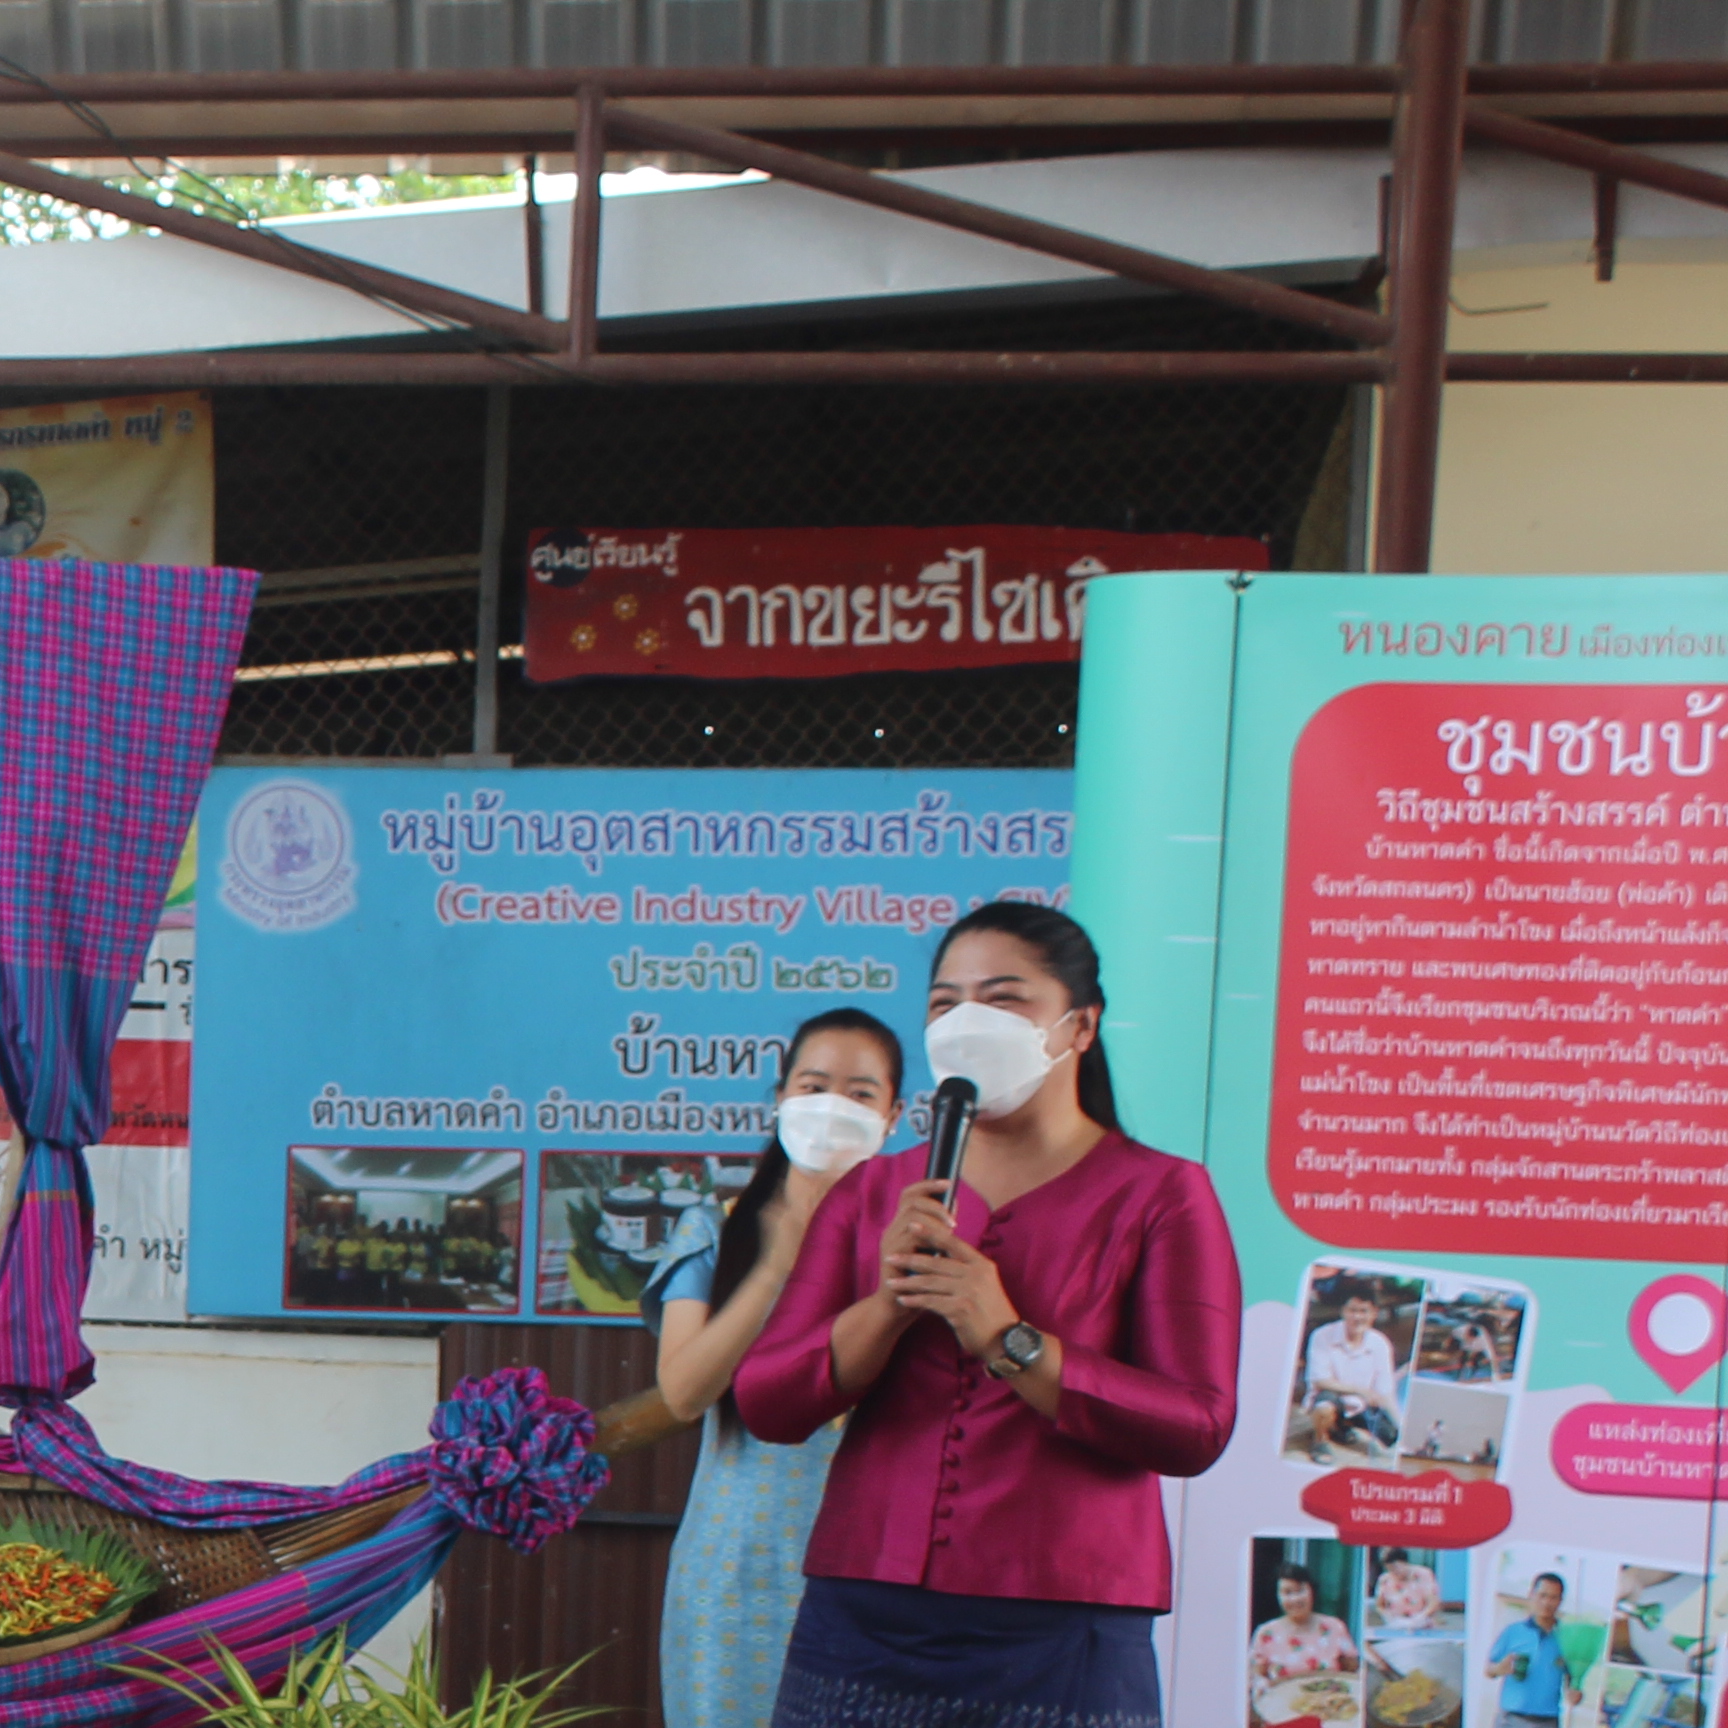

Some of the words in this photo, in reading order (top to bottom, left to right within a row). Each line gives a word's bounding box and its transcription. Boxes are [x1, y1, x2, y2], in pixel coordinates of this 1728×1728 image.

[530, 530, 684, 581] ศูนย์เรียนรู้
[1339, 618, 1572, 658] หนองคาย
[1375, 787, 1672, 832] วิถีชุมชนสร้างสรรค์
[1365, 833, 1486, 860] บ้านหาดคำ
[435, 885, 621, 925] (Creative
[632, 887, 804, 935] Industry
[817, 886, 955, 934] Village
[611, 943, 759, 992] ประจำปี
[773, 951, 897, 992] ๒๕๖๒
[1306, 958, 1405, 977] หาดทราย
[1300, 1064, 1392, 1094] แม่น้ำโขง
[312, 1088, 522, 1131] ตำบลหาดคำ
[1296, 1108, 1408, 1134] จำนวนมาก
[1292, 1188, 1364, 1212] หาดคำ
[1368, 1190, 1480, 1220] กลุ่มประมง
[1349, 1477, 1450, 1503] โปรแกรมที่
